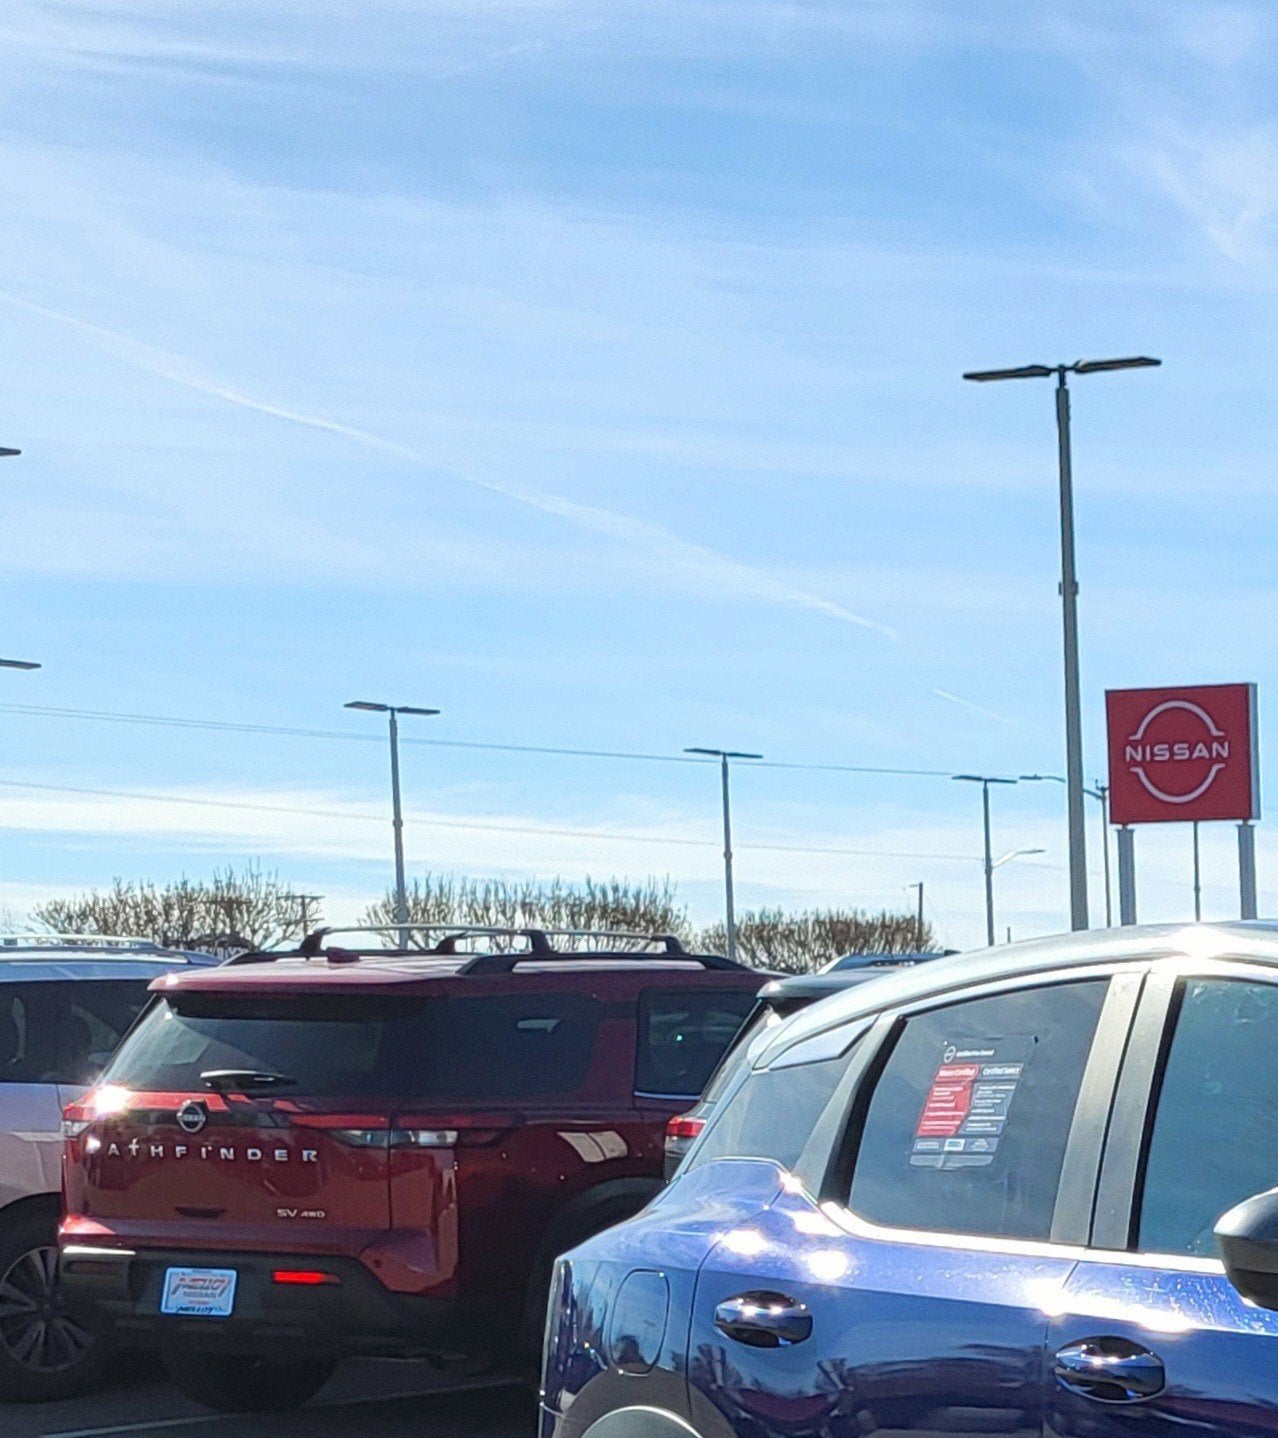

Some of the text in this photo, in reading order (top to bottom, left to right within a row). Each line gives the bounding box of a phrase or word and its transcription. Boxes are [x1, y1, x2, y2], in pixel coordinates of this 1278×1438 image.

[1125, 741, 1229, 762] NISSAN
[88, 1137, 319, 1162] ATHFINDER
[276, 1207, 298, 1218] SV
